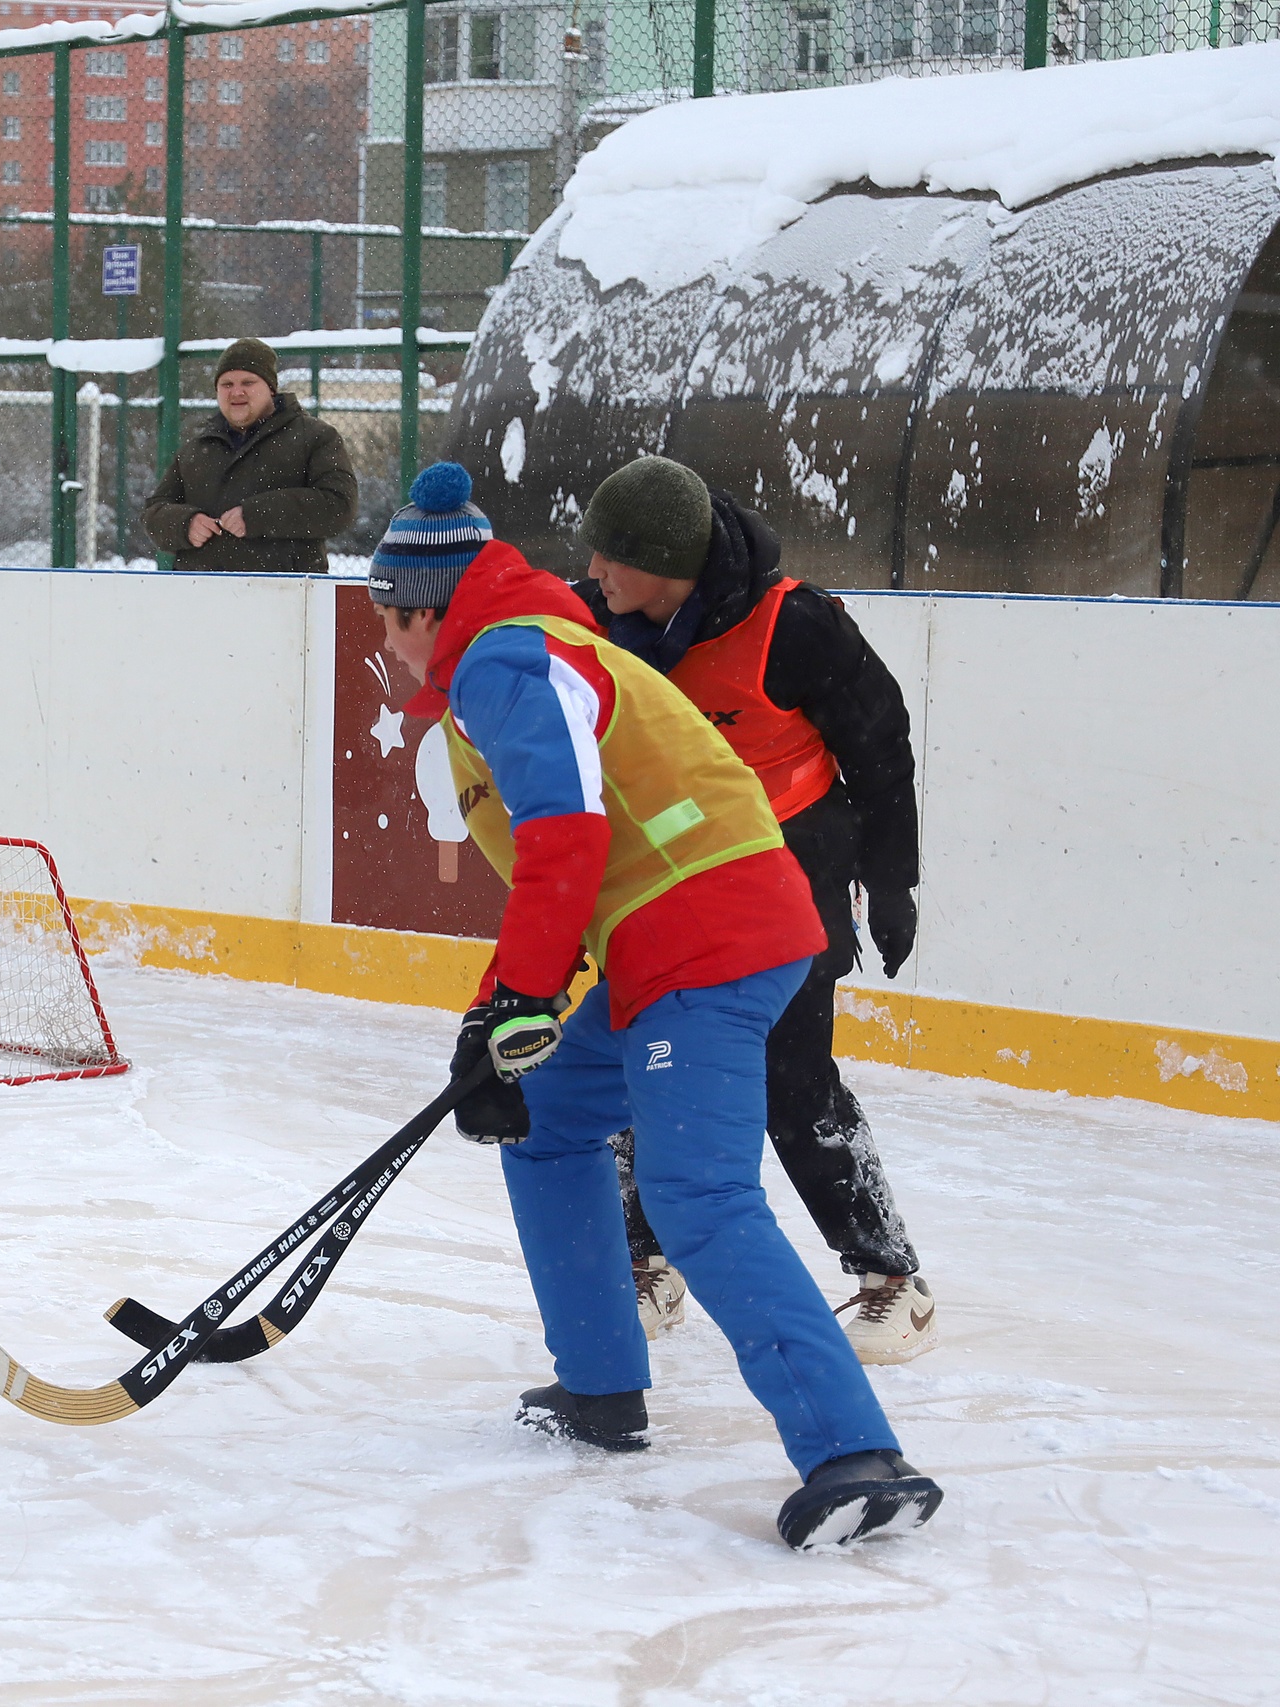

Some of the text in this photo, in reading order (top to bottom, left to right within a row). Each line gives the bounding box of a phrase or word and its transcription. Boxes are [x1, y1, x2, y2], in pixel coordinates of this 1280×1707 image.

[503, 1035, 550, 1057] reusch
[646, 1060, 673, 1071] PATRICK
[351, 1167, 394, 1219] ORANGE
[226, 1224, 309, 1300] ORANGE HAIL
[281, 1246, 331, 1314] STEX
[140, 1320, 200, 1385] STEX
